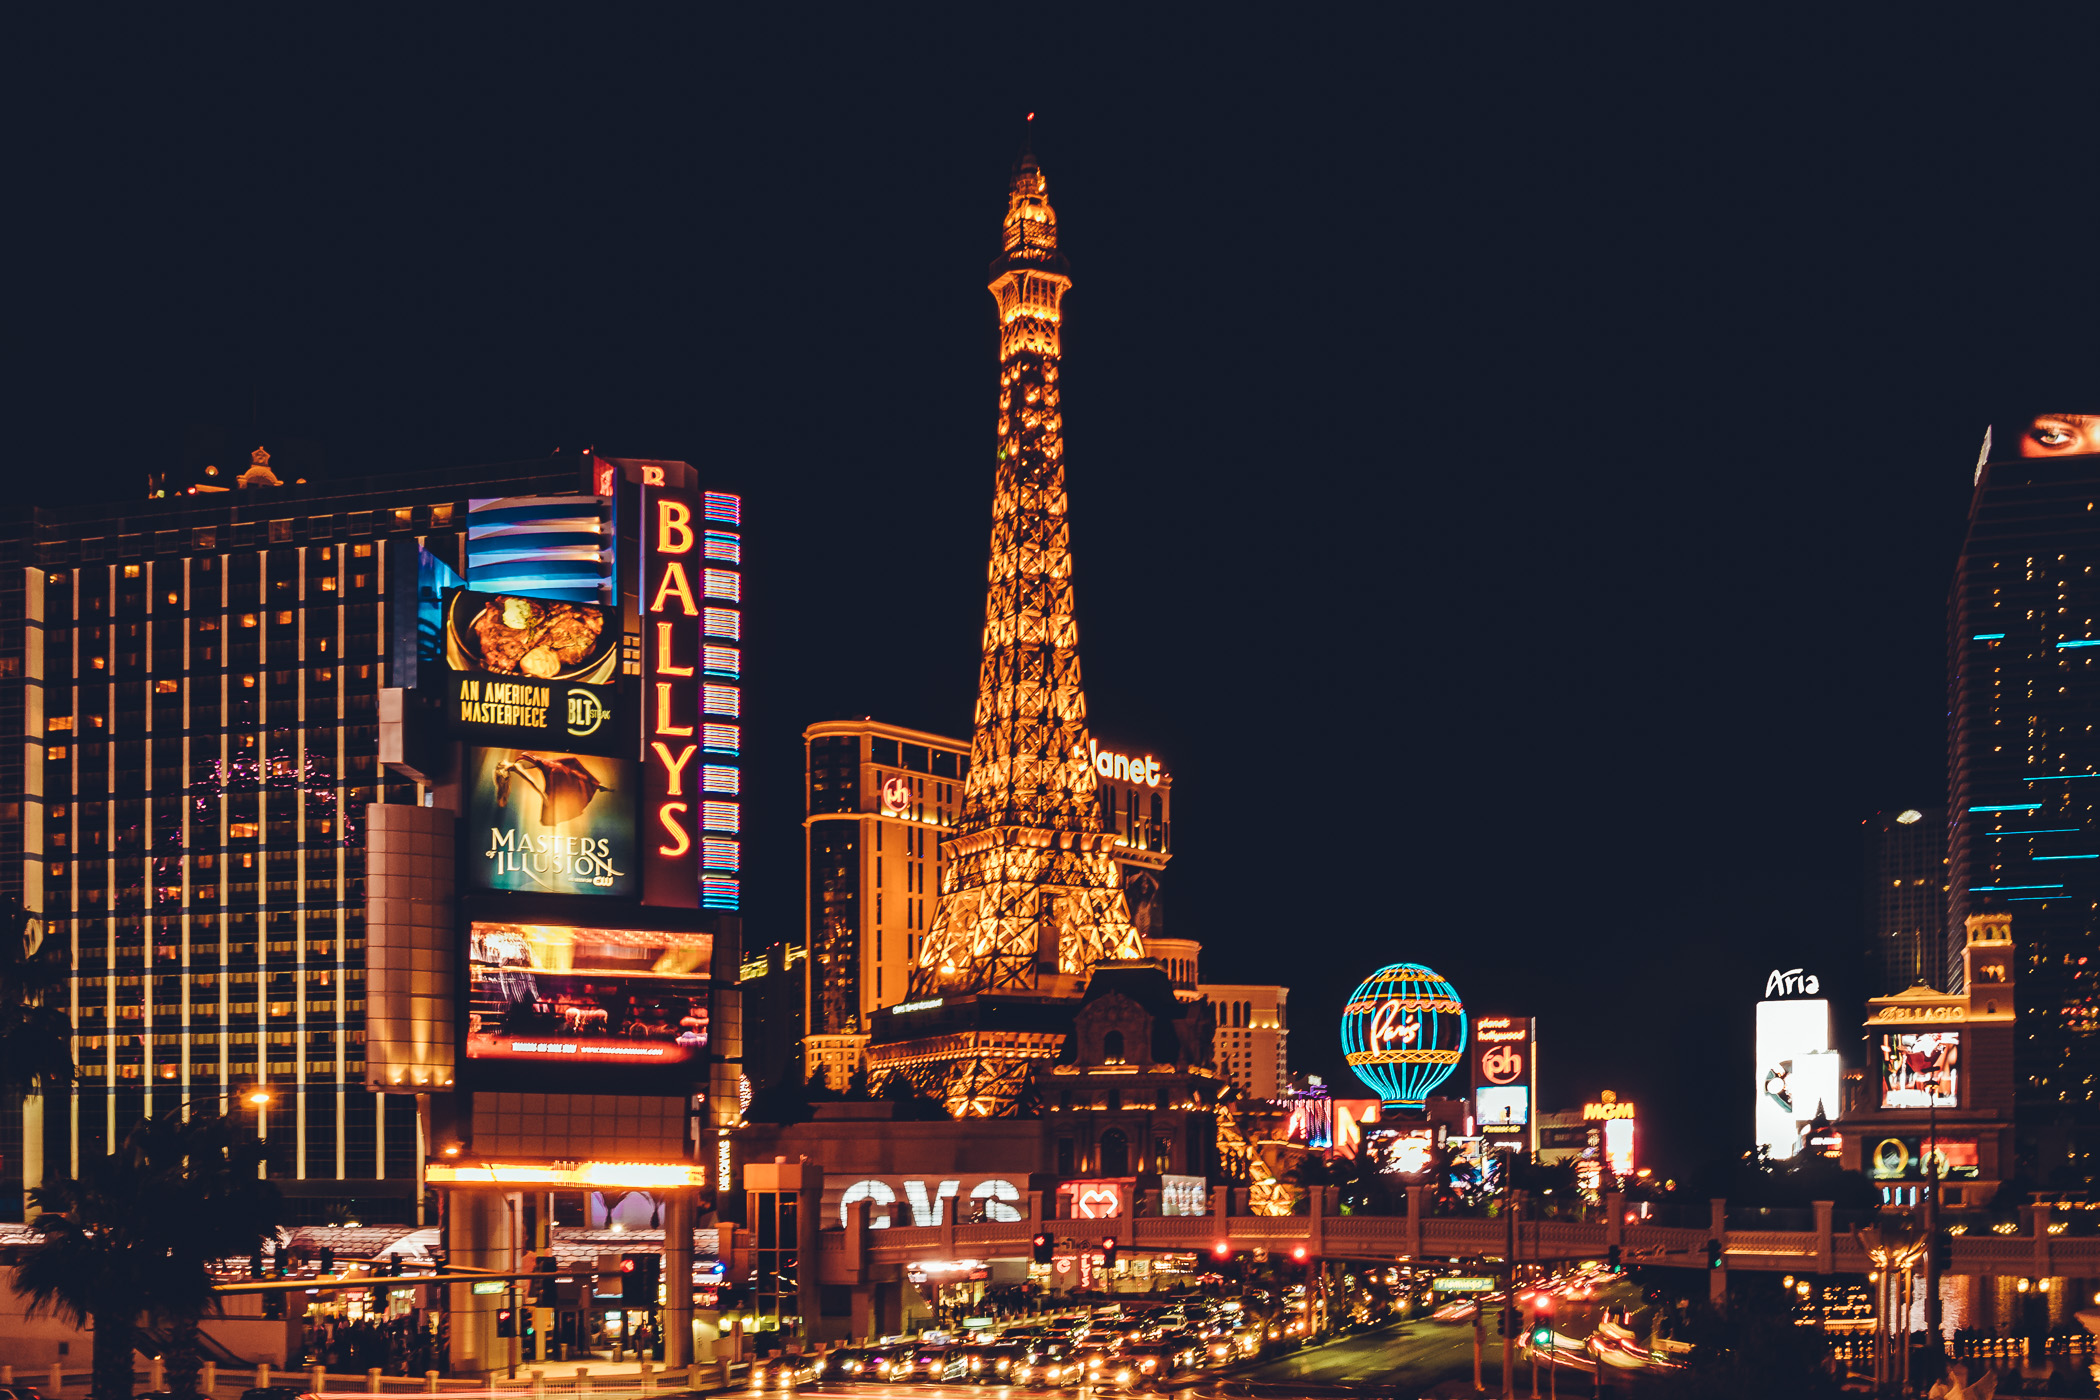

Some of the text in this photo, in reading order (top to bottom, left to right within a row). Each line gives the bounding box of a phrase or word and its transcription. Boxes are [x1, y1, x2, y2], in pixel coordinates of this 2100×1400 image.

[650, 499, 699, 857] BALLYS
[460, 680, 550, 708] AN AMERICAN
[461, 701, 548, 729] MASTERPIECE
[567, 698, 593, 726] BLT
[1073, 738, 1161, 788] lanet
[491, 827, 612, 862] MASTERS
[497, 850, 615, 879] ILLUSION
[1765, 968, 1820, 998] Aria
[1370, 999, 1421, 1058] Paris
[1878, 1006, 1965, 1021] BELLAGIO
[1583, 1102, 1635, 1120] MGM
[718, 1139, 731, 1192] SWAROVSKI
[840, 1179, 1022, 1230] CVS
